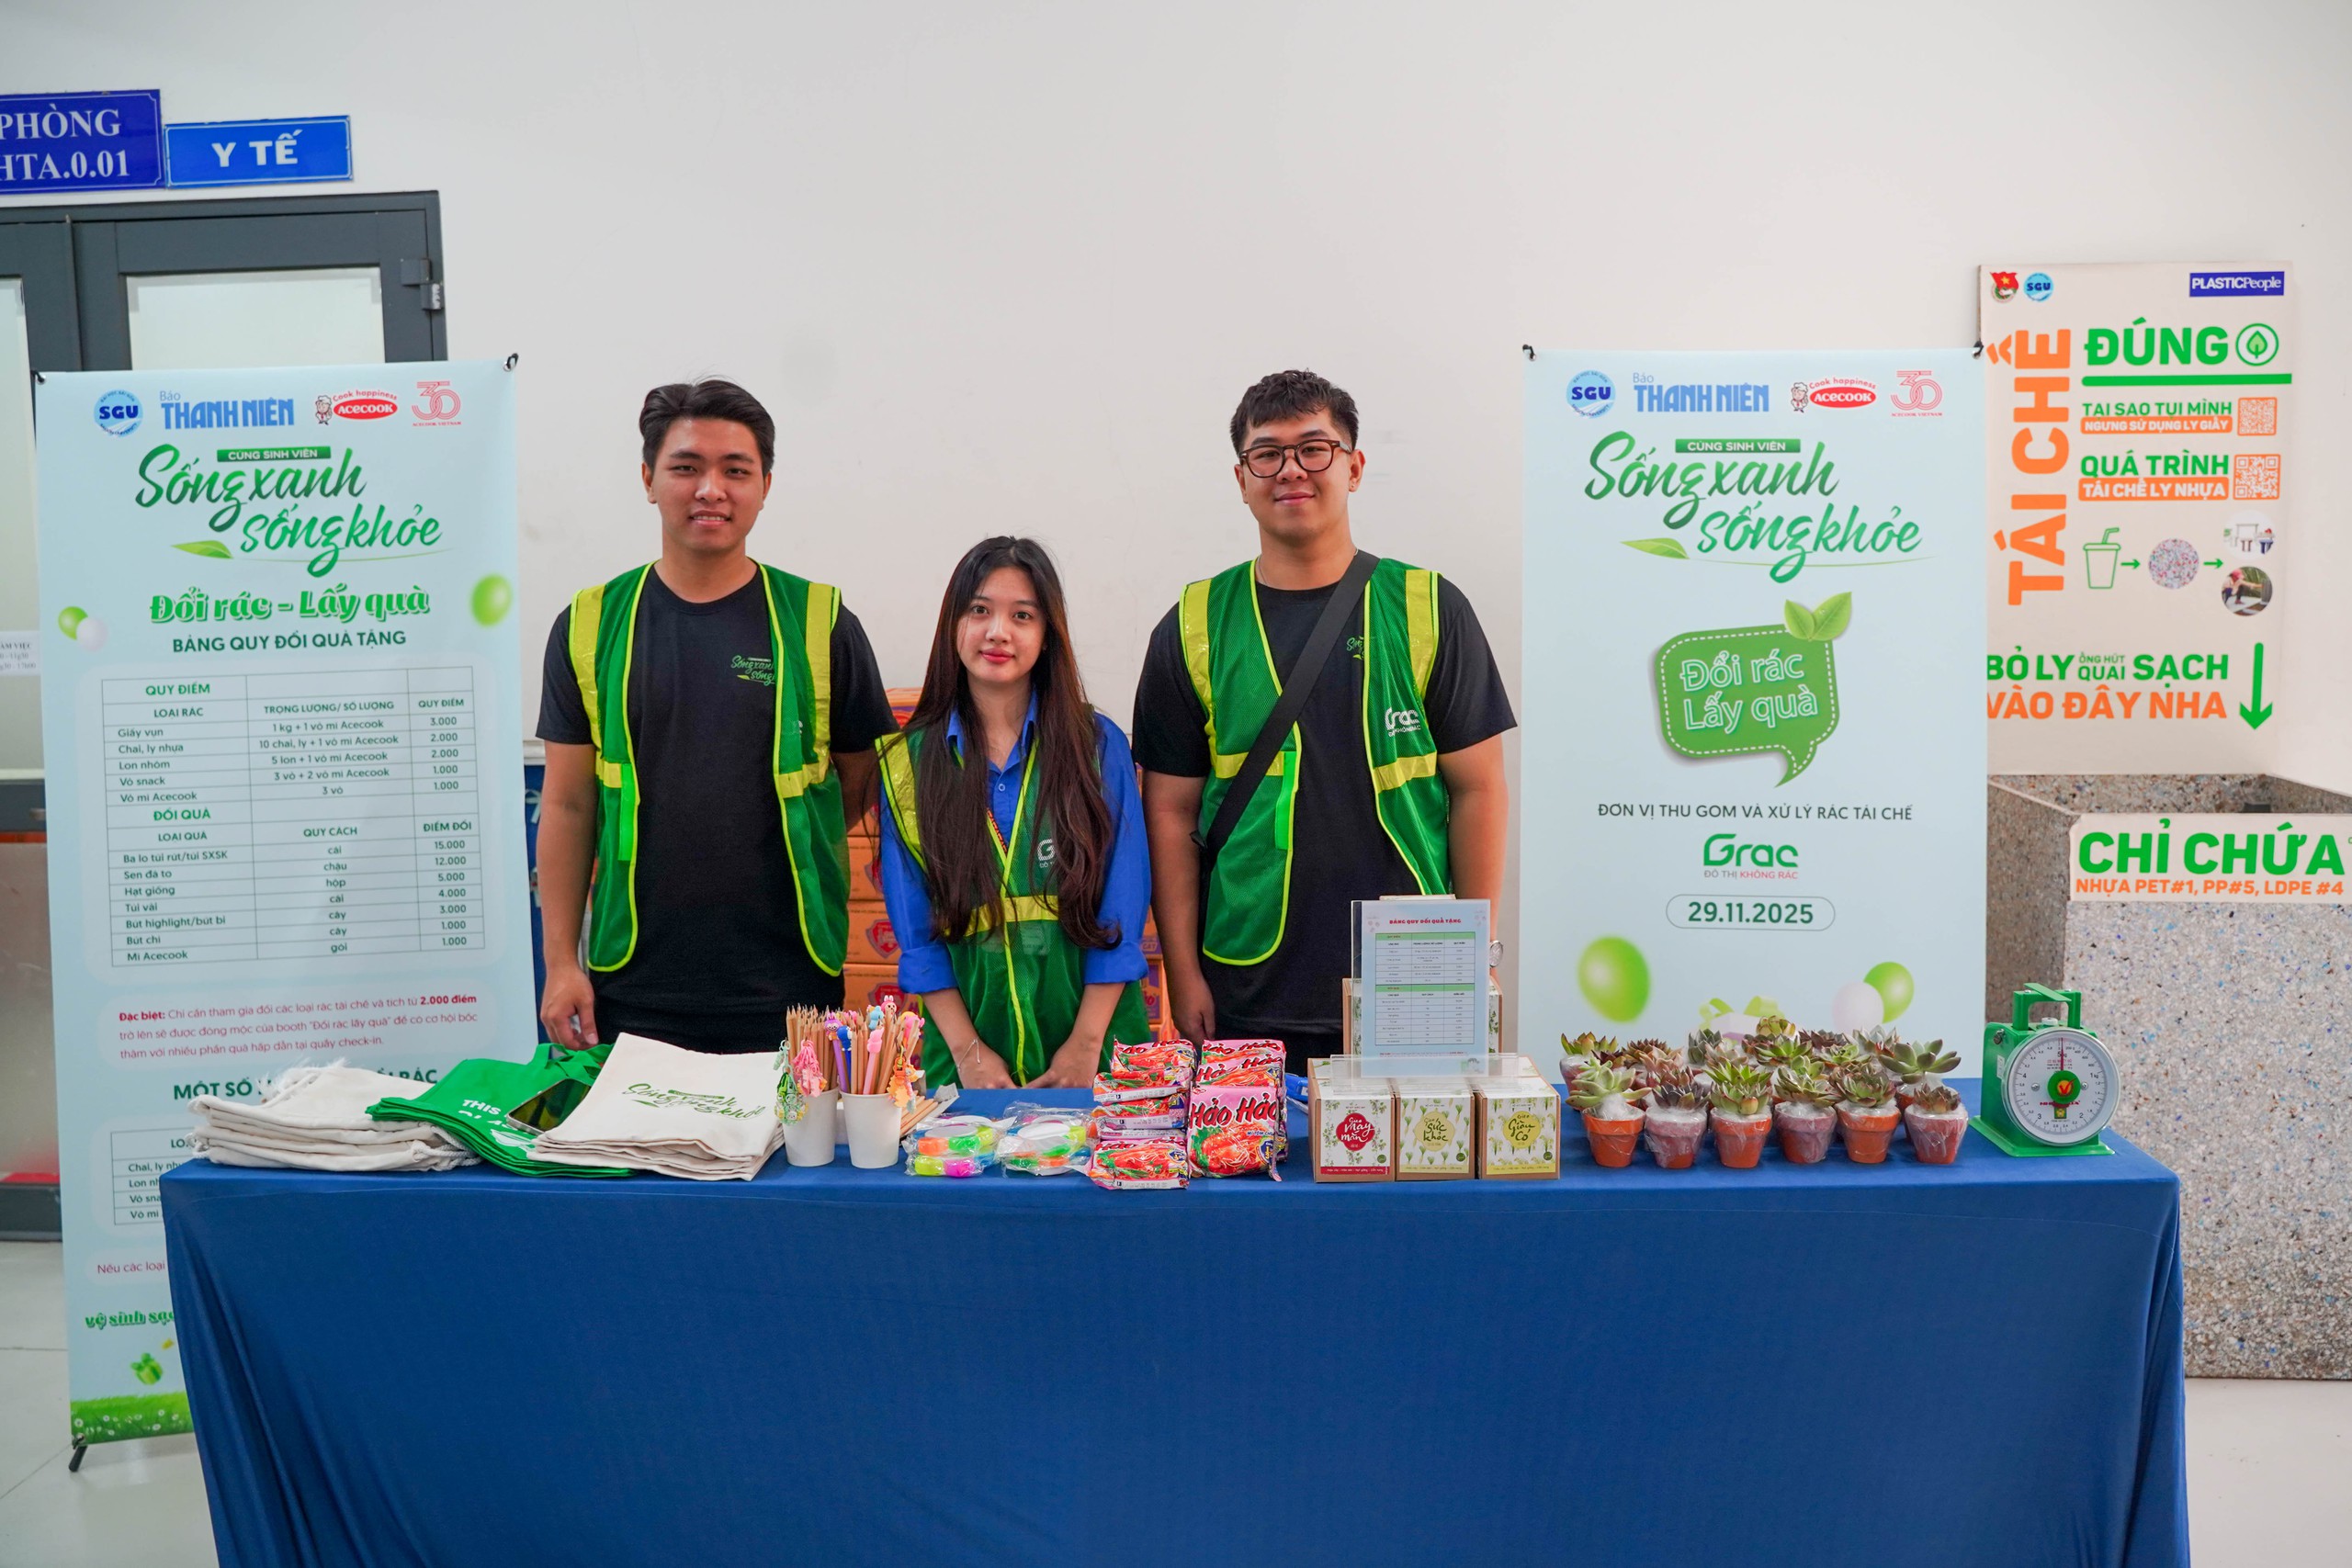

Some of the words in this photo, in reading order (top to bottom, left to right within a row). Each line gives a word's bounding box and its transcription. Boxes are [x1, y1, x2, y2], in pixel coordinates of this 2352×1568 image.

[0, 103, 121, 140] PHÒNG
[211, 141, 237, 168] Y
[248, 129, 303, 165] TẾ
[2026, 280, 2052, 292] SGU
[2084, 316, 2229, 367] ĐÚNG
[1633, 372, 1654, 383] Báo
[1809, 378, 1830, 389] Cook
[1833, 377, 1877, 389] happiness
[159, 390, 181, 401] Báo
[332, 390, 354, 402] Cook
[356, 389, 398, 401] happiness
[1571, 386, 1611, 400] SGU
[1634, 384, 1713, 412] THANH
[1715, 382, 1770, 412] NIÊN
[1986, 328, 2071, 475] CHẾ
[99, 405, 139, 420] SGU
[161, 400, 239, 430] THANH
[241, 397, 295, 427] NIÊN
[2082, 402, 2110, 420] TẠI
[2114, 402, 2151, 416] SAO
[2154, 402, 2183, 419] TỤI
[2186, 398, 2233, 416] MÌNH
[2085, 419, 2128, 432] NGƯNG
[2148, 420, 2181, 434] DỤNG
[2183, 420, 2199, 431] LY
[2200, 415, 2229, 431] GIẤY
[228, 447, 262, 461] CÙNG
[264, 448, 288, 460] SINH
[290, 446, 319, 458] VIÊN
[1687, 439, 1723, 452] CÙNG
[1725, 442, 1755, 452] SINH
[1757, 439, 1786, 452] VIÊN
[2080, 449, 2140, 478] QUÁ
[2145, 449, 2230, 476] TRÌNH
[134, 443, 248, 533] Sống
[247, 447, 368, 502] xanh
[1584, 431, 1707, 530] Sống
[1706, 441, 1841, 498] xanh
[2082, 479, 2110, 498] TÁI
[2112, 477, 2148, 498] CHẾ
[2150, 483, 2172, 498] LY
[2174, 481, 2226, 500] NHỰA
[239, 503, 345, 578] sống
[1696, 502, 1815, 584] sống
[1993, 494, 2067, 605] TÁI
[150, 586, 209, 624] Đổi
[214, 588, 273, 620] rác
[299, 583, 362, 622] Lấy
[365, 585, 432, 621] quà
[172, 632, 225, 652] BẢNG
[229, 635, 269, 650] QUY
[274, 630, 308, 649] ĐỔI
[313, 629, 354, 649] QUÀ
[356, 628, 407, 649] TẶNG
[1679, 650, 1743, 693] Đổi
[1751, 649, 1805, 685] rác
[1986, 646, 2029, 681] BỎ
[2037, 654, 2075, 681] LY
[2077, 665, 2126, 682] QUAI
[2132, 654, 2229, 688] SẠCH
[145, 684, 175, 696] QUY
[1682, 691, 1744, 734] Lấy
[1750, 684, 1819, 728] quà
[1986, 684, 2054, 720] VÀO
[2062, 683, 2142, 720] ĐÂY
[2148, 691, 2228, 719] NHA
[153, 708, 179, 719] LOẠI
[182, 706, 204, 717] RÁC
[429, 716, 458, 727] 3.000
[430, 732, 458, 742] 2.000
[147, 744, 156, 754] ly
[431, 749, 459, 759] 2.000
[119, 761, 138, 771] Lon
[433, 765, 458, 774] 1.000
[137, 776, 166, 785] snack
[153, 807, 178, 821] ĐỔI
[181, 807, 211, 820] QUÀ
[1598, 802, 1634, 818] ĐƠN
[1638, 804, 1656, 820] VỊ
[1658, 805, 1691, 818] THU
[1696, 805, 1737, 818] GOM
[1742, 801, 1764, 818] VÀ
[1767, 801, 1792, 818] XỬ
[1794, 802, 1814, 818] LÝ
[1817, 802, 1849, 819] RÁC
[1853, 802, 1878, 819] TÁI
[1881, 802, 1914, 820] CHẾ
[434, 840, 466, 850] 15.000
[1702, 833, 1799, 868] Grac
[2078, 818, 2172, 874] CHỈ
[2183, 821, 2346, 875] CHỨA
[435, 856, 467, 865] 12.000
[437, 873, 466, 882] 5.000
[1703, 868, 1720, 879] ĐÔ
[1740, 868, 1776, 879] KHÔNG
[1777, 869, 1799, 880] RÁC
[124, 886, 142, 897] Hạt
[438, 888, 467, 897] 4.000
[2075, 878, 2131, 897] NHỰA
[2264, 880, 2312, 896] LDPE
[2315, 881, 2345, 896] #4
[1688, 901, 1815, 925] 29.11.2025
[420, 995, 449, 1006] 2.000
[462, 1099, 502, 1115] THIS
[1189, 1097, 1233, 1129] Hảo
[108, 1310, 146, 1327] sinh
